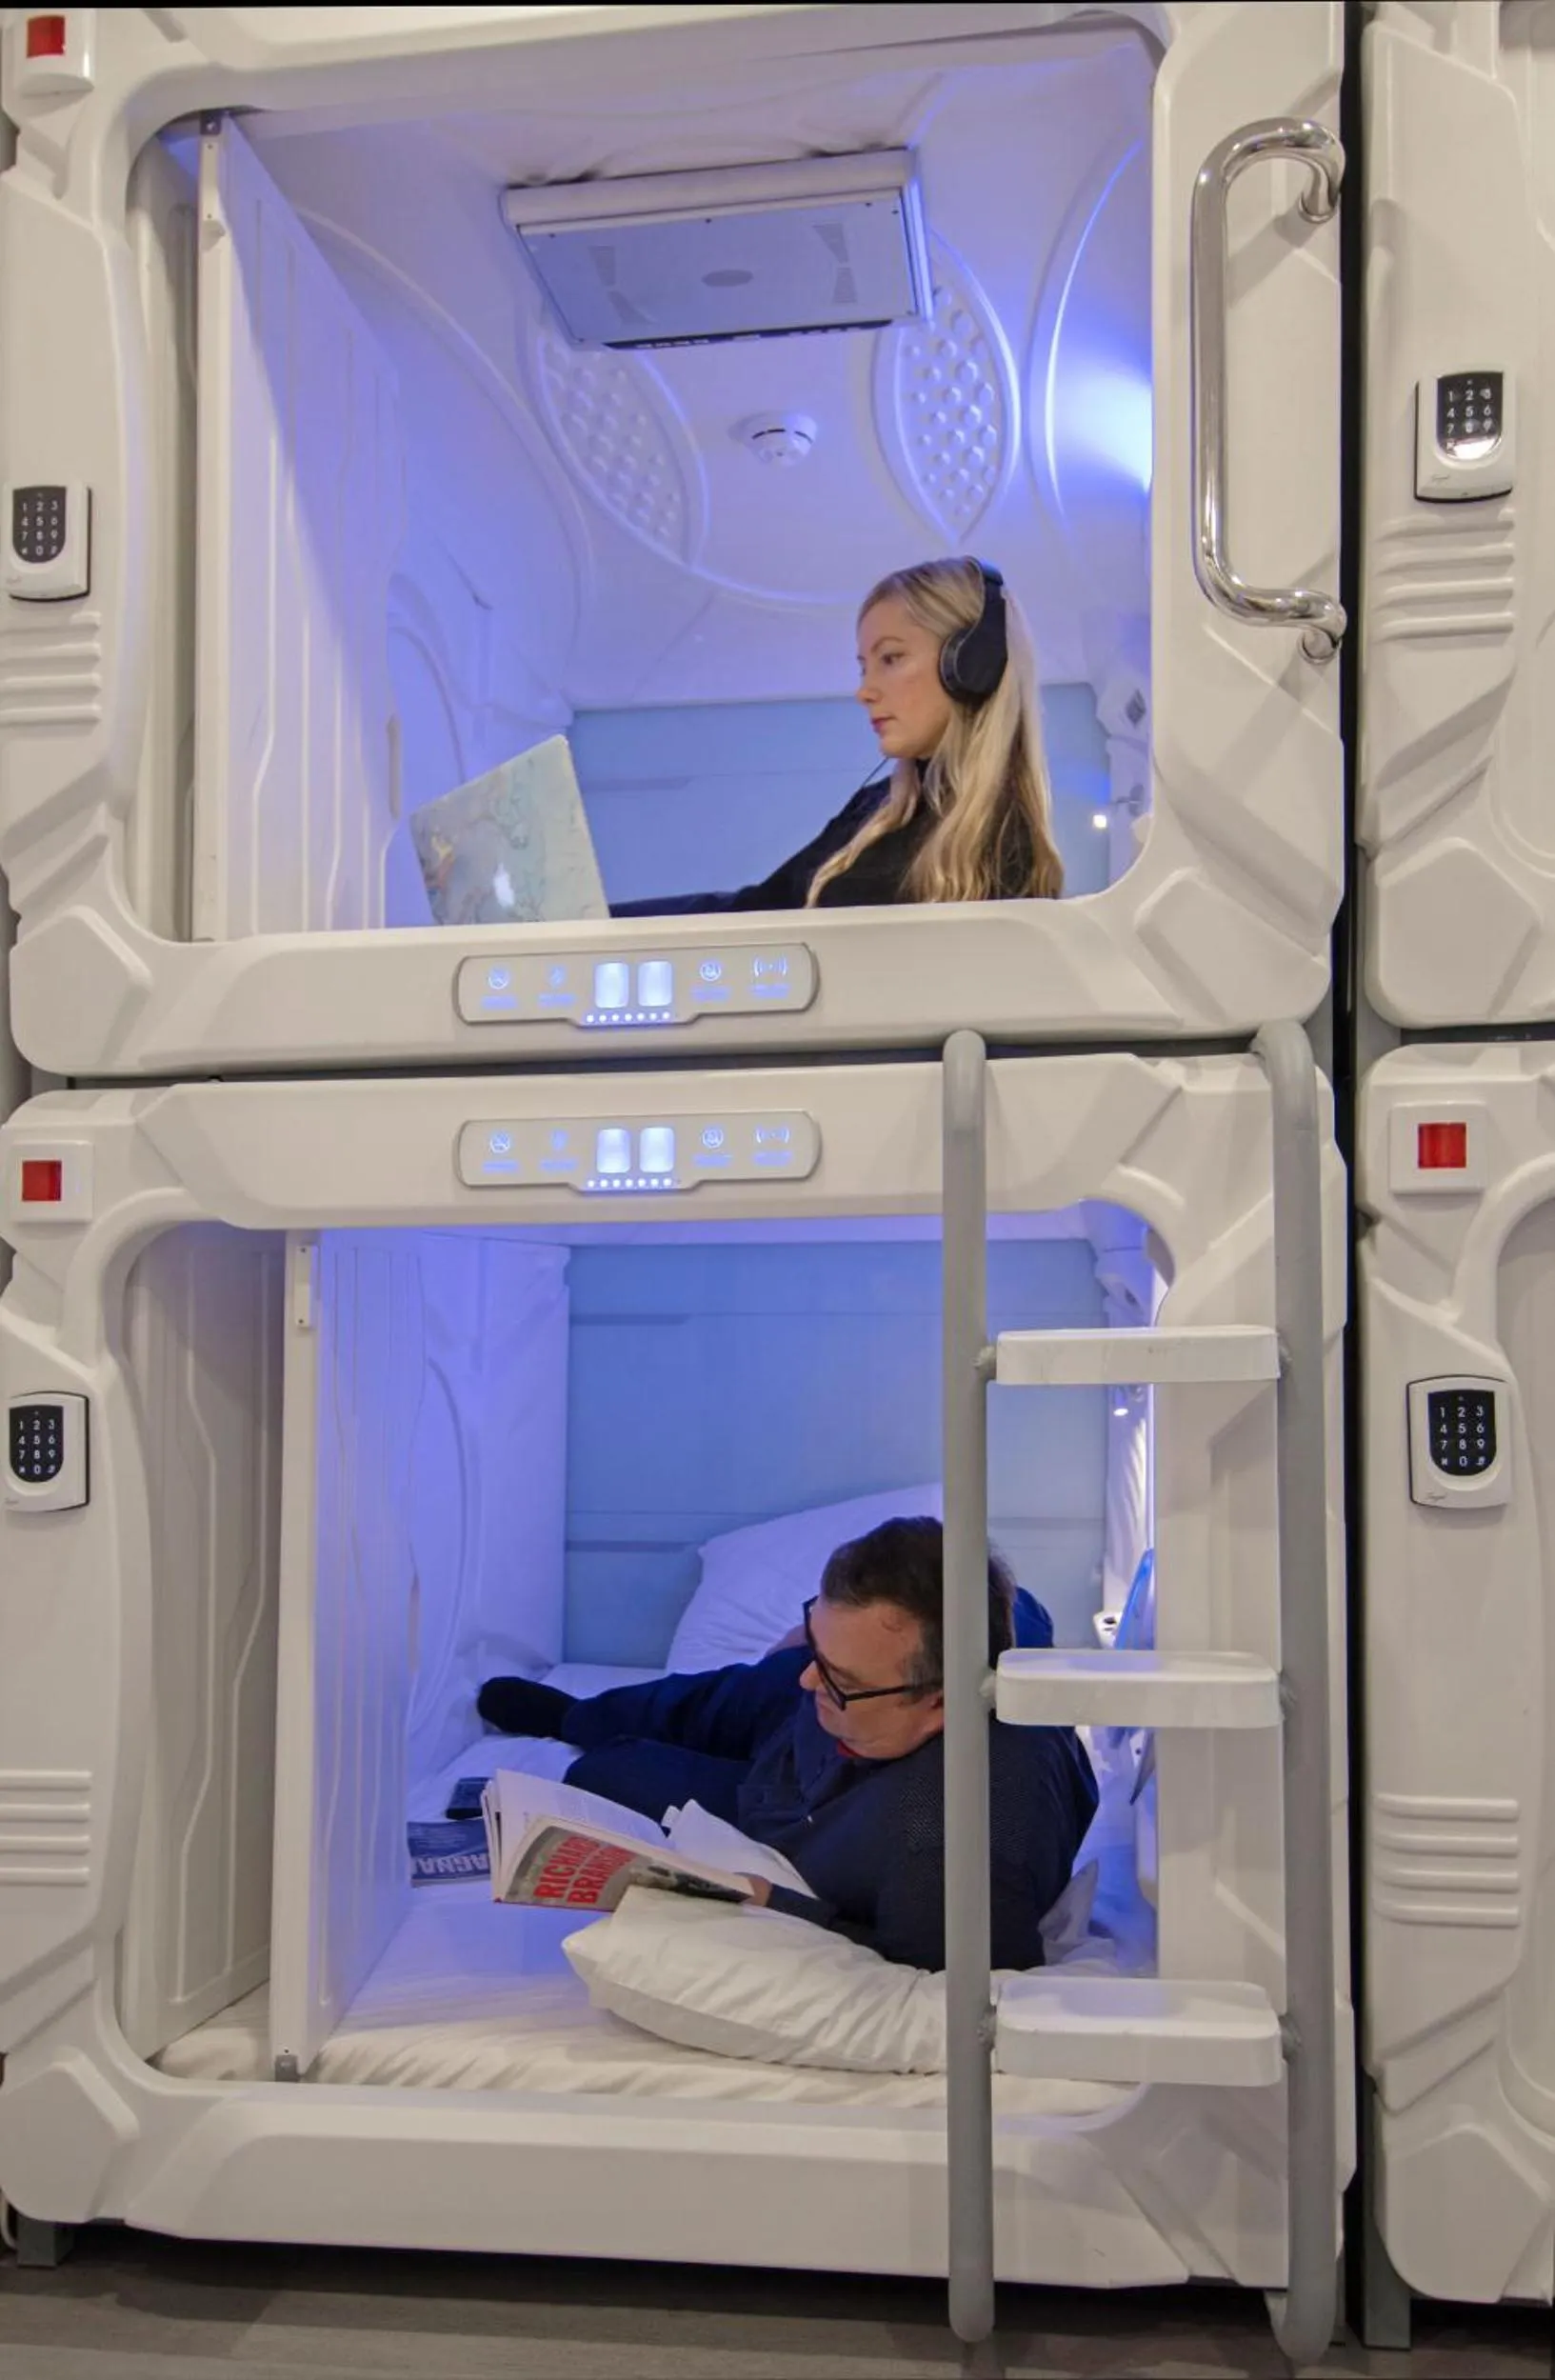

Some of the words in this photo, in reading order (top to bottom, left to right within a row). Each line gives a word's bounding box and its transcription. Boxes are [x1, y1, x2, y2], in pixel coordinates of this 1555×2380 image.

[1448, 391, 1453, 402] 1
[1465, 390, 1474, 400] 2
[1447, 408, 1455, 418] 4
[1465, 406, 1473, 416] 5
[1484, 405, 1491, 415] 6
[1447, 424, 1454, 434] 7
[1440, 1407, 1445, 1418] 1
[1458, 1407, 1465, 1417] 2
[1477, 1406, 1484, 1416] 3
[19, 1421, 24, 1430] 1
[33, 1420, 40, 1430] 2
[49, 1419, 54, 1430] 3
[1440, 1425, 1447, 1434] 4
[1458, 1424, 1466, 1433] 5
[1477, 1423, 1484, 1432] 6
[18, 1436, 25, 1445] 4
[33, 1435, 40, 1445] 5
[49, 1435, 55, 1444] 6
[1441, 1441, 1447, 1450] 7
[1459, 1440, 1466, 1450] 8
[1477, 1440, 1485, 1449] 9
[19, 1450, 25, 1459] 7
[34, 1450, 40, 1459] 8
[49, 1450, 55, 1458] 9
[1460, 1456, 1467, 1466] 0
[33, 1465, 40, 1474] 0
